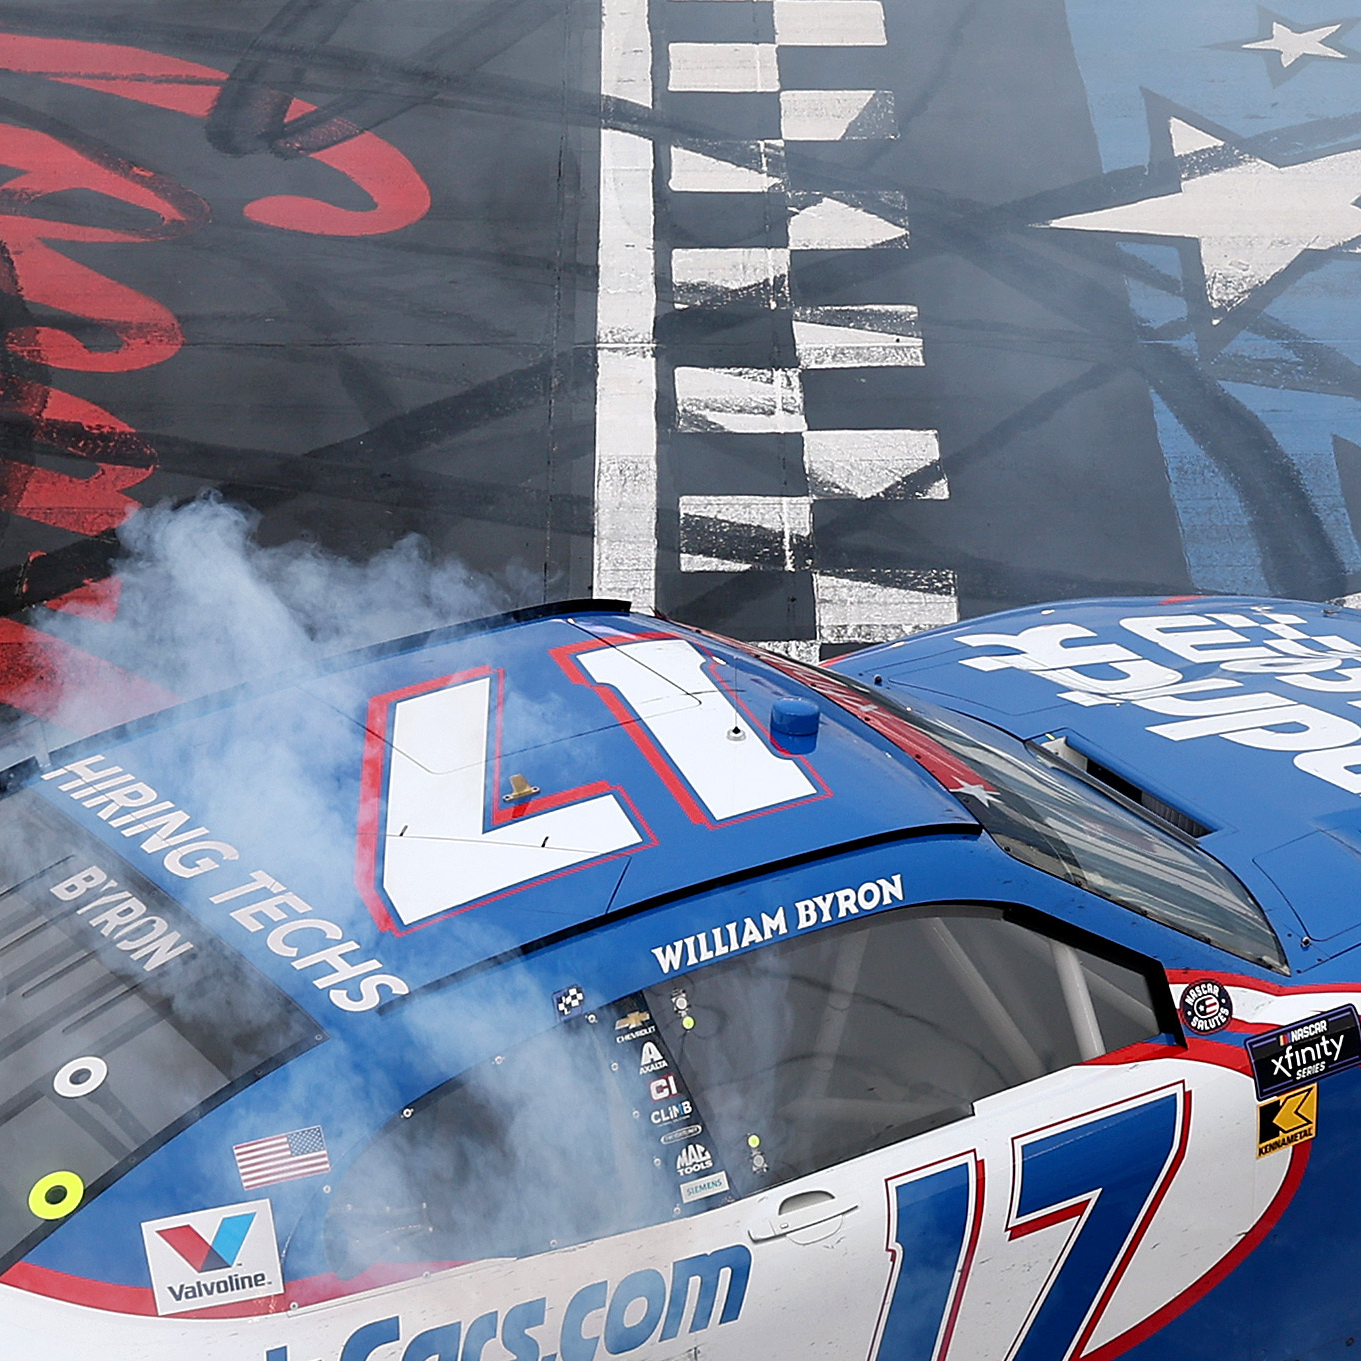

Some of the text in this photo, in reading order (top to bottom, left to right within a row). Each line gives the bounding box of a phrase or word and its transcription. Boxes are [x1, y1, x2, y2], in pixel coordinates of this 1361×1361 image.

[356, 632, 832, 937] 17
[40, 754, 410, 1014] HIRING TECHS
[49, 865, 193, 972] BYRON
[651, 873, 906, 975] WILLIAM BYRON
[1185, 983, 1220, 1006] NASCAR
[1190, 1007, 1230, 1031] SALUTES
[1290, 1019, 1328, 1043] NASCAR
[639, 1060, 669, 1076] AXALTA
[1270, 1034, 1345, 1078] xfinity
[1295, 1061, 1327, 1081] SERIES
[1257, 1126, 1314, 1157] KENNAMETAL
[676, 1143, 712, 1170] MAC
[677, 1159, 714, 1177] TOOLS
[686, 1178, 723, 1197] SIEMENS
[167, 1272, 266, 1302] Valvoline
